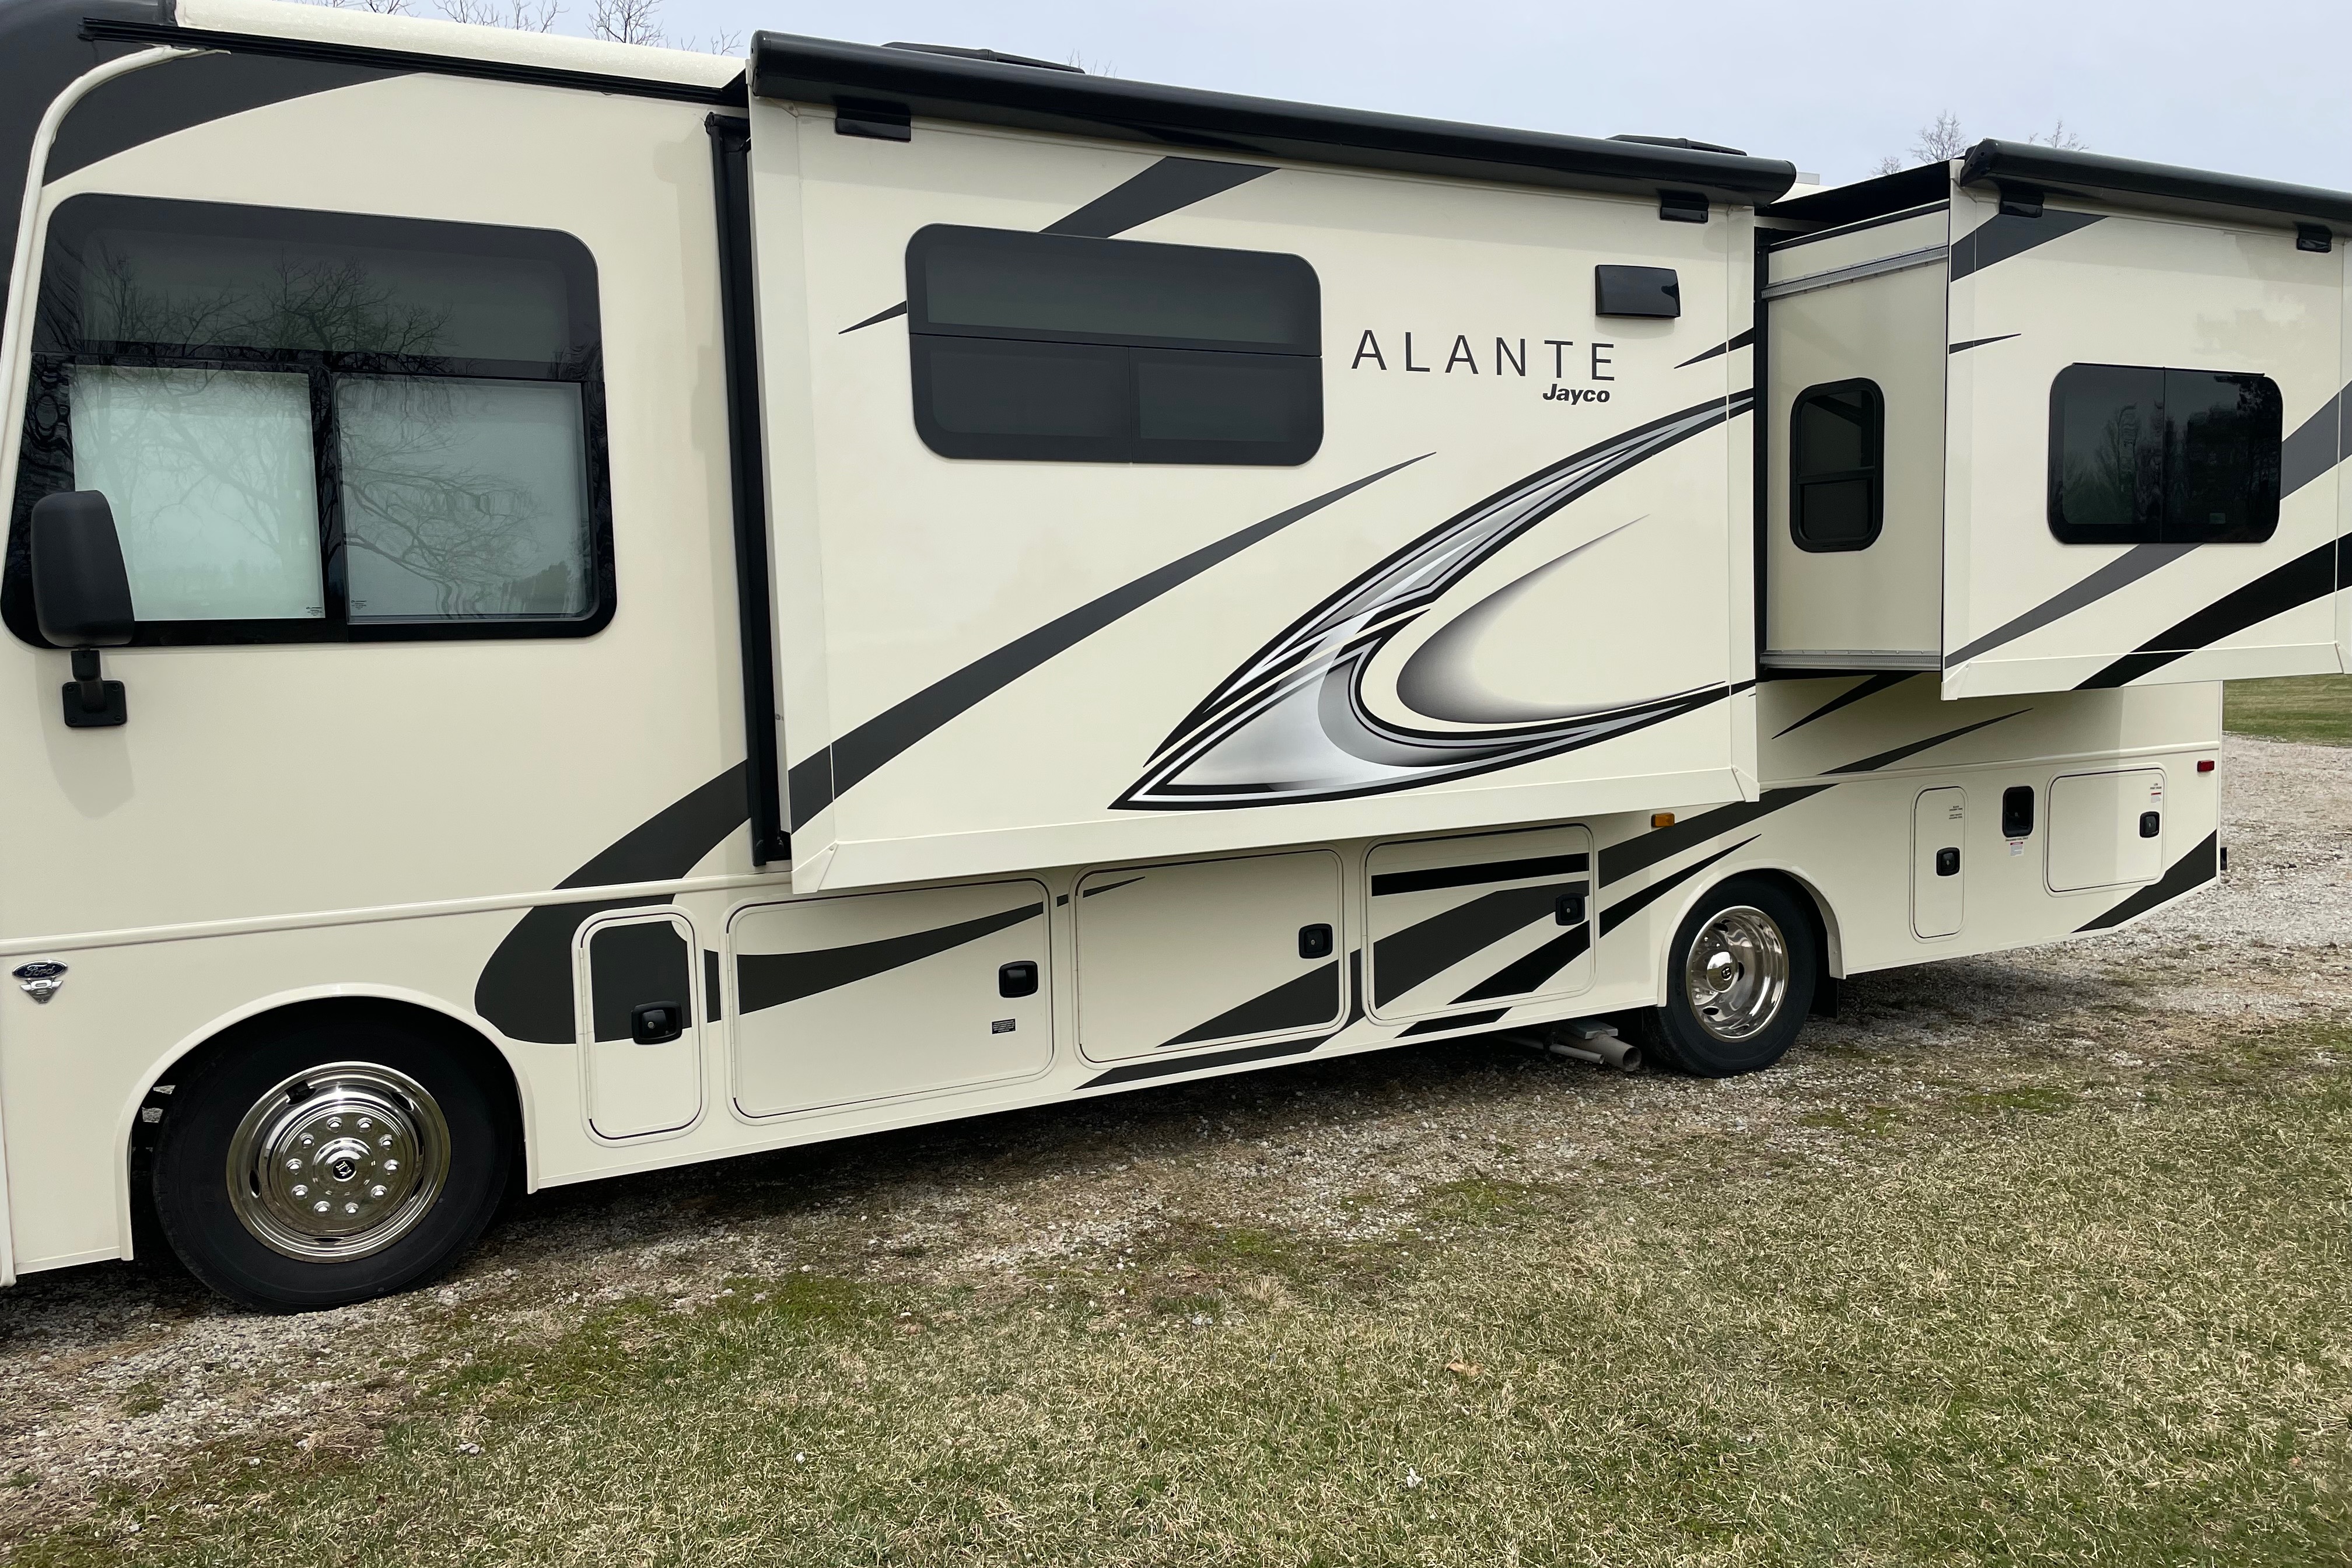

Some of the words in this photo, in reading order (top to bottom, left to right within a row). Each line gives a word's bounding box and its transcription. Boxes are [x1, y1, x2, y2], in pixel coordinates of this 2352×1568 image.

[1351, 330, 1615, 381] ALANTE
[1542, 383, 1610, 405] Jayco
[24, 964, 56, 977] Ford
